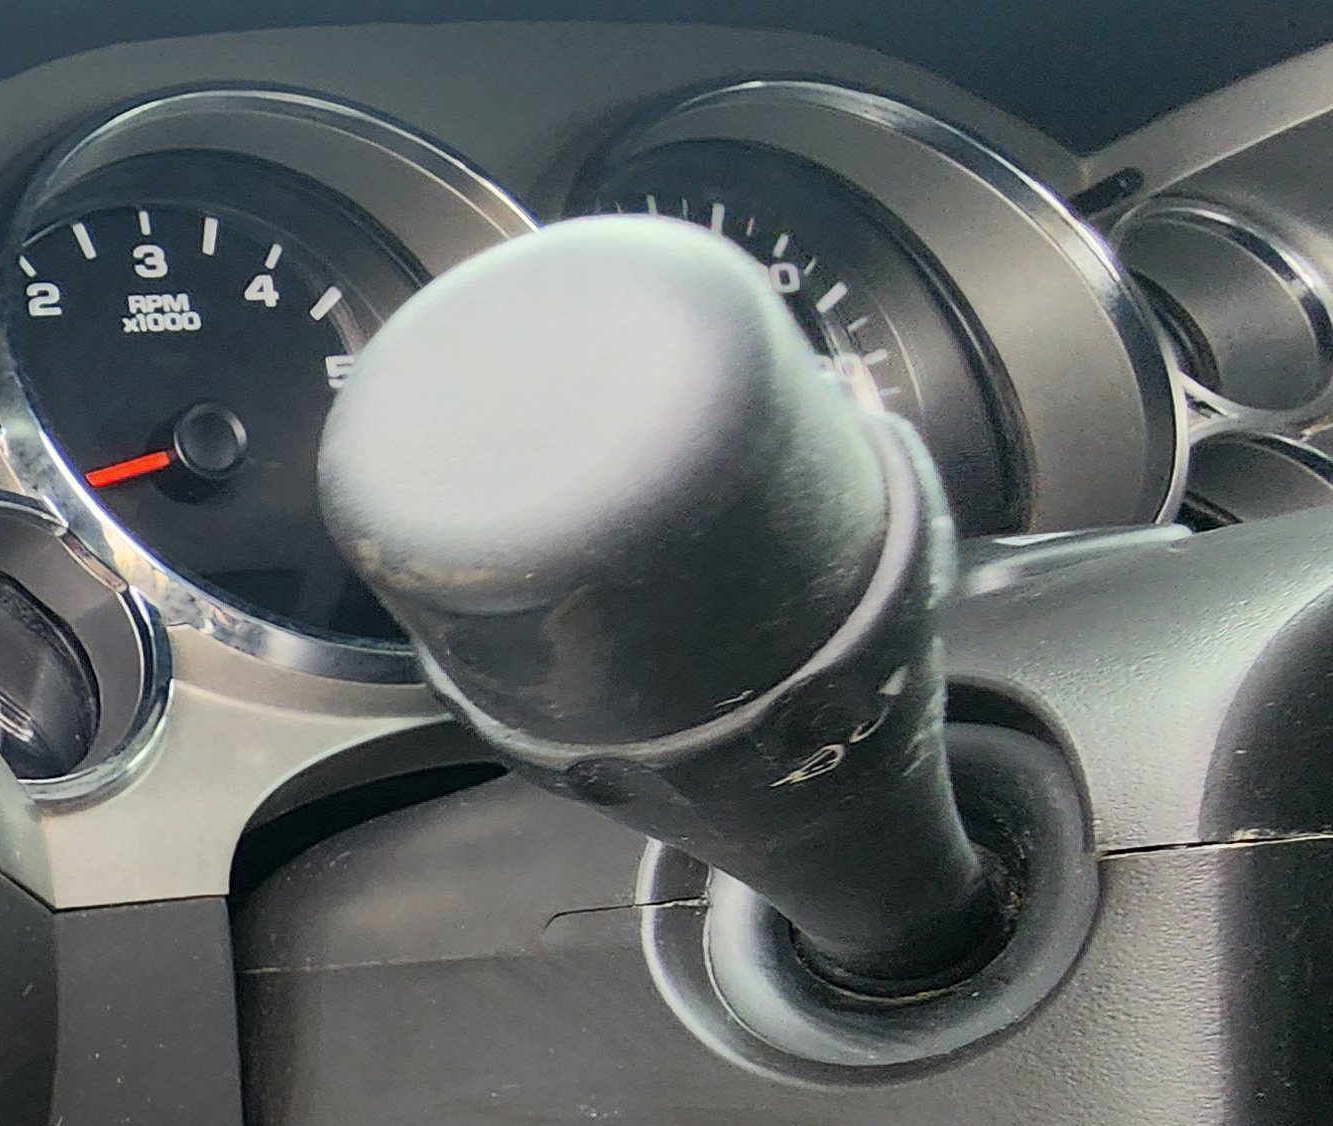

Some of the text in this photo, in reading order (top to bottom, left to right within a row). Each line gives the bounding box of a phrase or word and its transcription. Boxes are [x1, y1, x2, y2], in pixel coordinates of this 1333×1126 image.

[132, 244, 169, 279] 3
[25, 281, 63, 318] 2
[127, 292, 191, 314] RPM
[244, 273, 280, 309] 4
